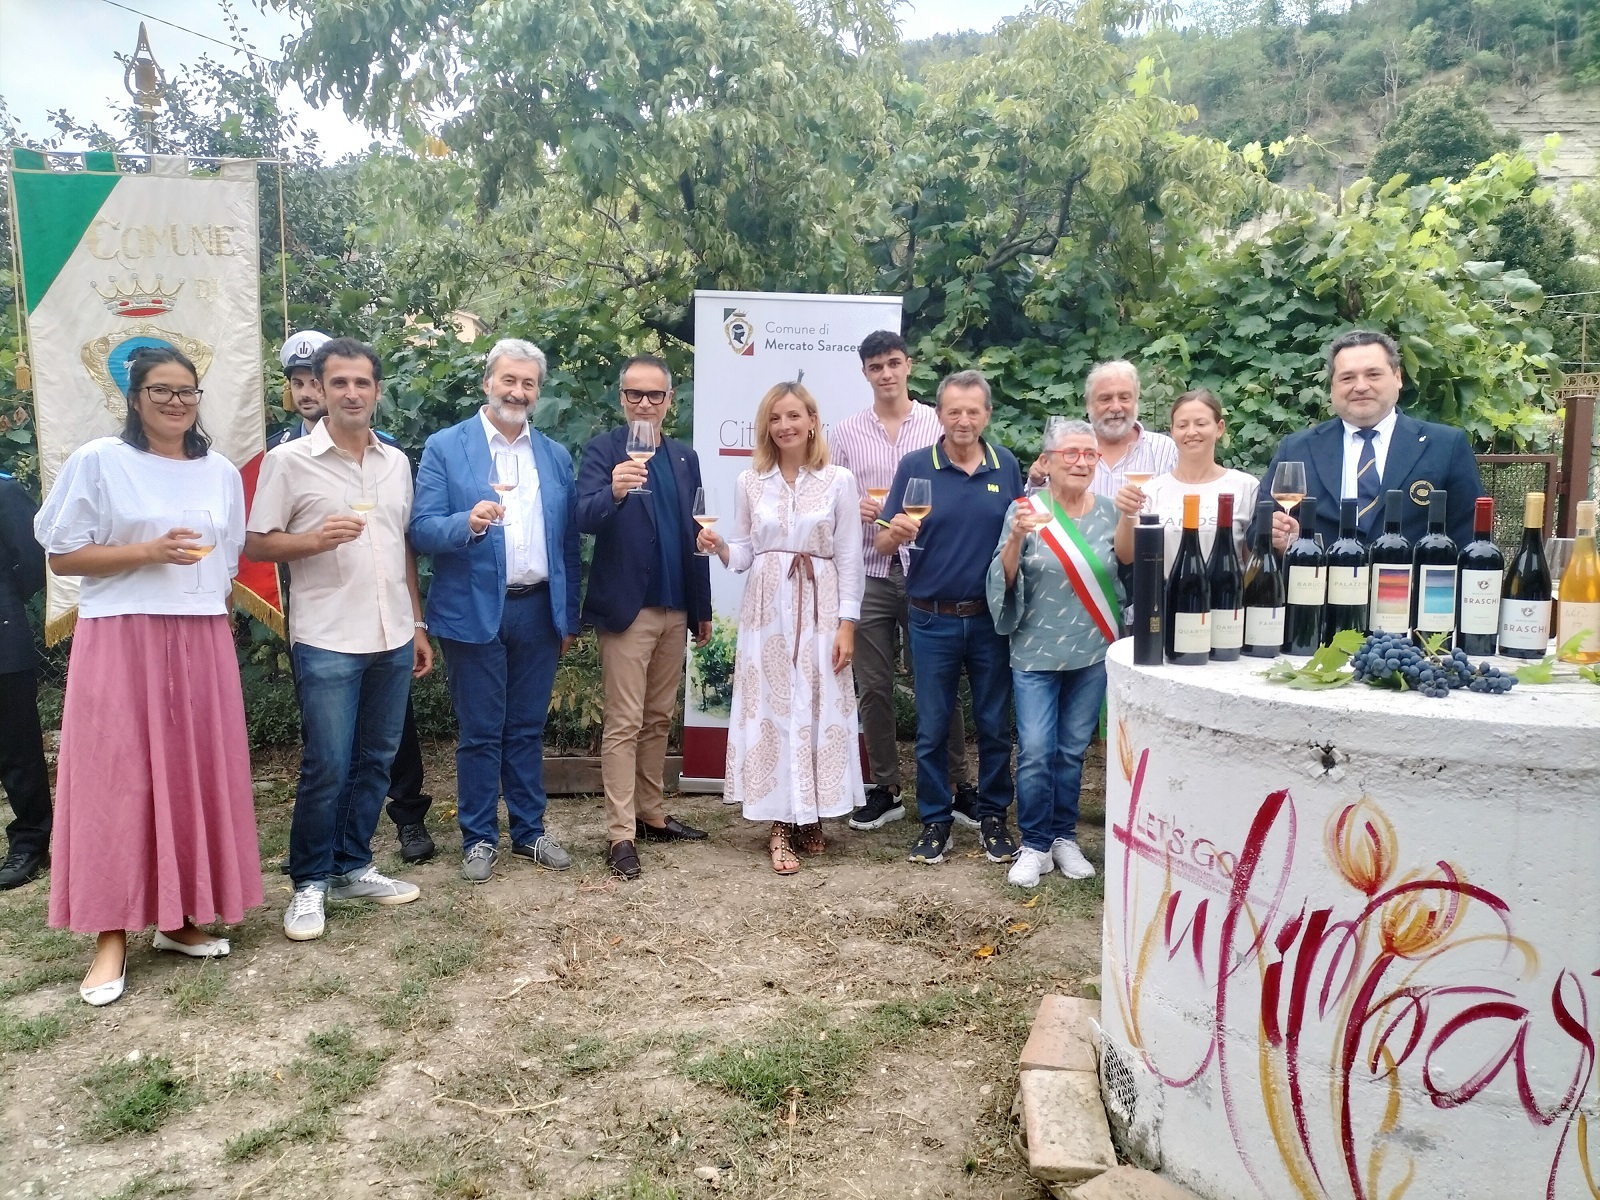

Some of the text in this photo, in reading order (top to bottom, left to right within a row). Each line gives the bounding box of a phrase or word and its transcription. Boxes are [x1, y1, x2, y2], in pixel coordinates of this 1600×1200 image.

[84, 217, 238, 269] COMUNE
[765, 321, 830, 335] Comune di
[765, 338, 861, 352] Mercato Saracen
[719, 420, 755, 447] Cit
[1464, 597, 1499, 605] BRASCHI
[1503, 623, 1547, 634] BRASCHI
[1136, 805, 1240, 880] LET'S GO
